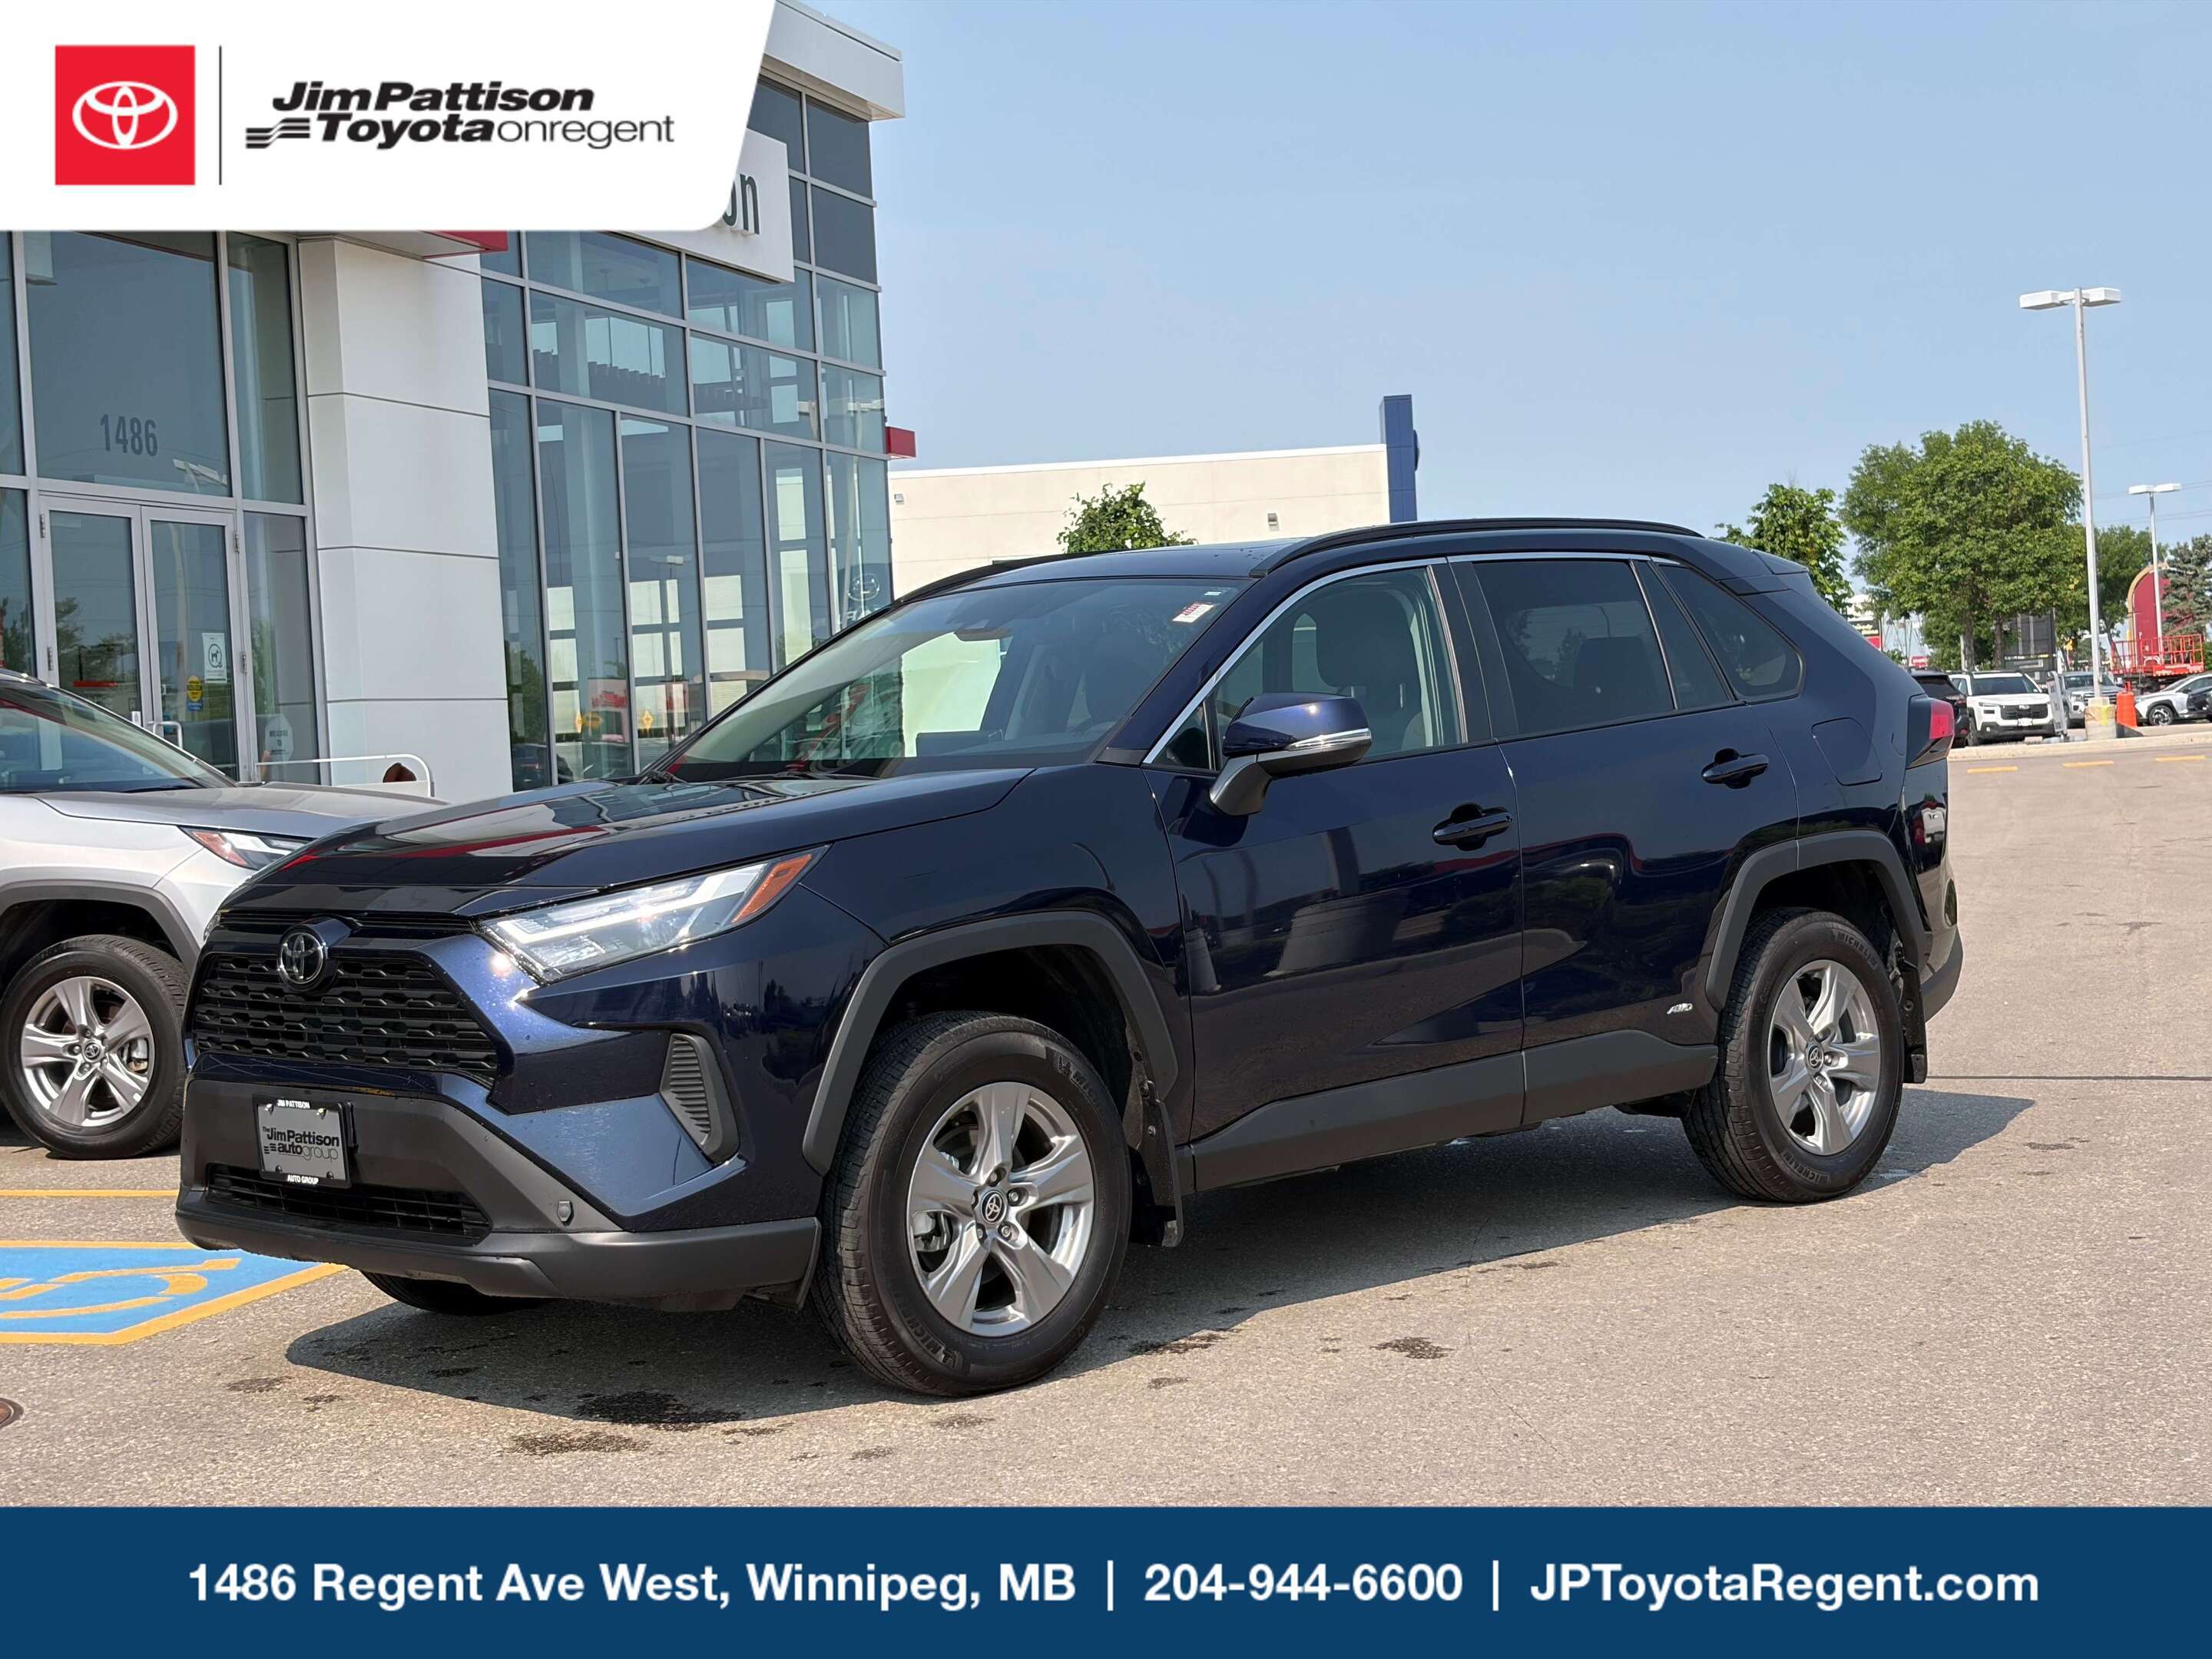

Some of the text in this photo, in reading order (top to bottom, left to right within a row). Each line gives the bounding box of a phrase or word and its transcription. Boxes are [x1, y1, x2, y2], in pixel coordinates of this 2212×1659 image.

[100, 413, 158, 456] 1486
[287, 1174, 319, 1184] AUTO GROUP
